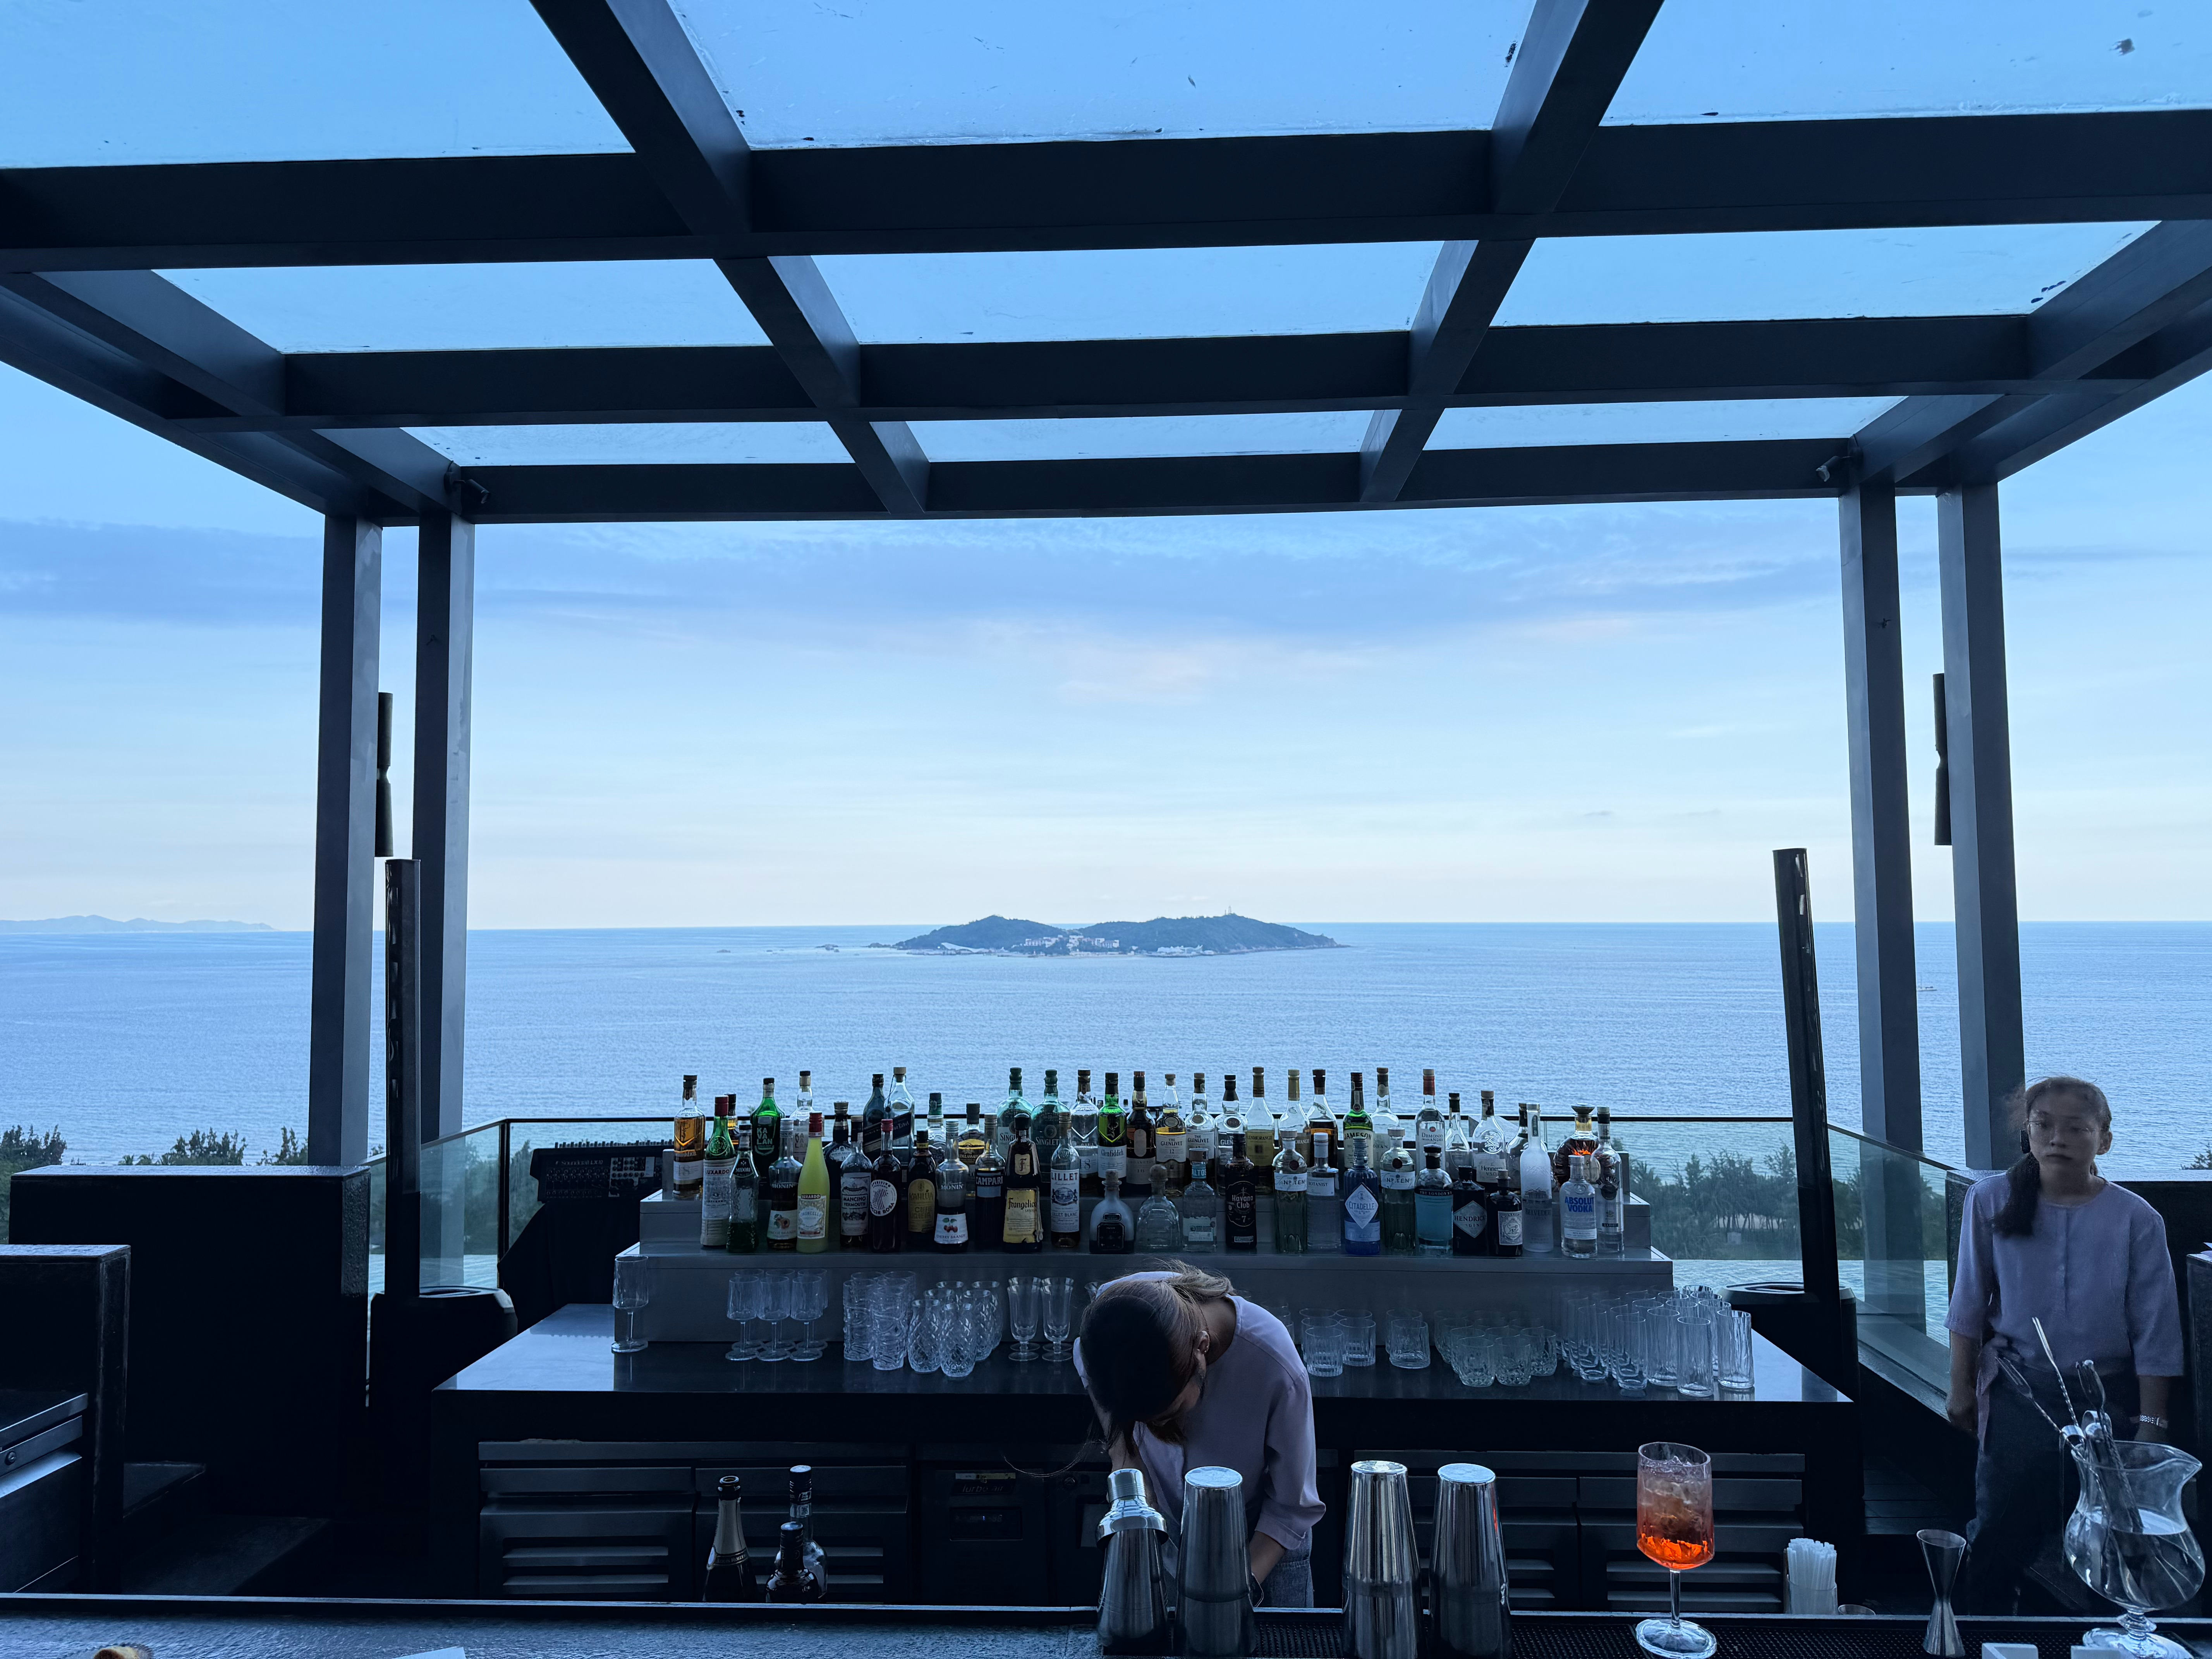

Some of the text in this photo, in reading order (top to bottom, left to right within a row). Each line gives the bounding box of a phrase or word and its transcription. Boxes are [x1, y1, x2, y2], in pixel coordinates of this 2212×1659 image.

[976, 1176, 1003, 1185] CAMPARI
[1051, 1172, 1078, 1181] LILLET
[1565, 1196, 1594, 1205] ABSOLUT
[1349, 1201, 1375, 1210] CITADELLE
[1568, 1204, 1593, 1212] VODKA
